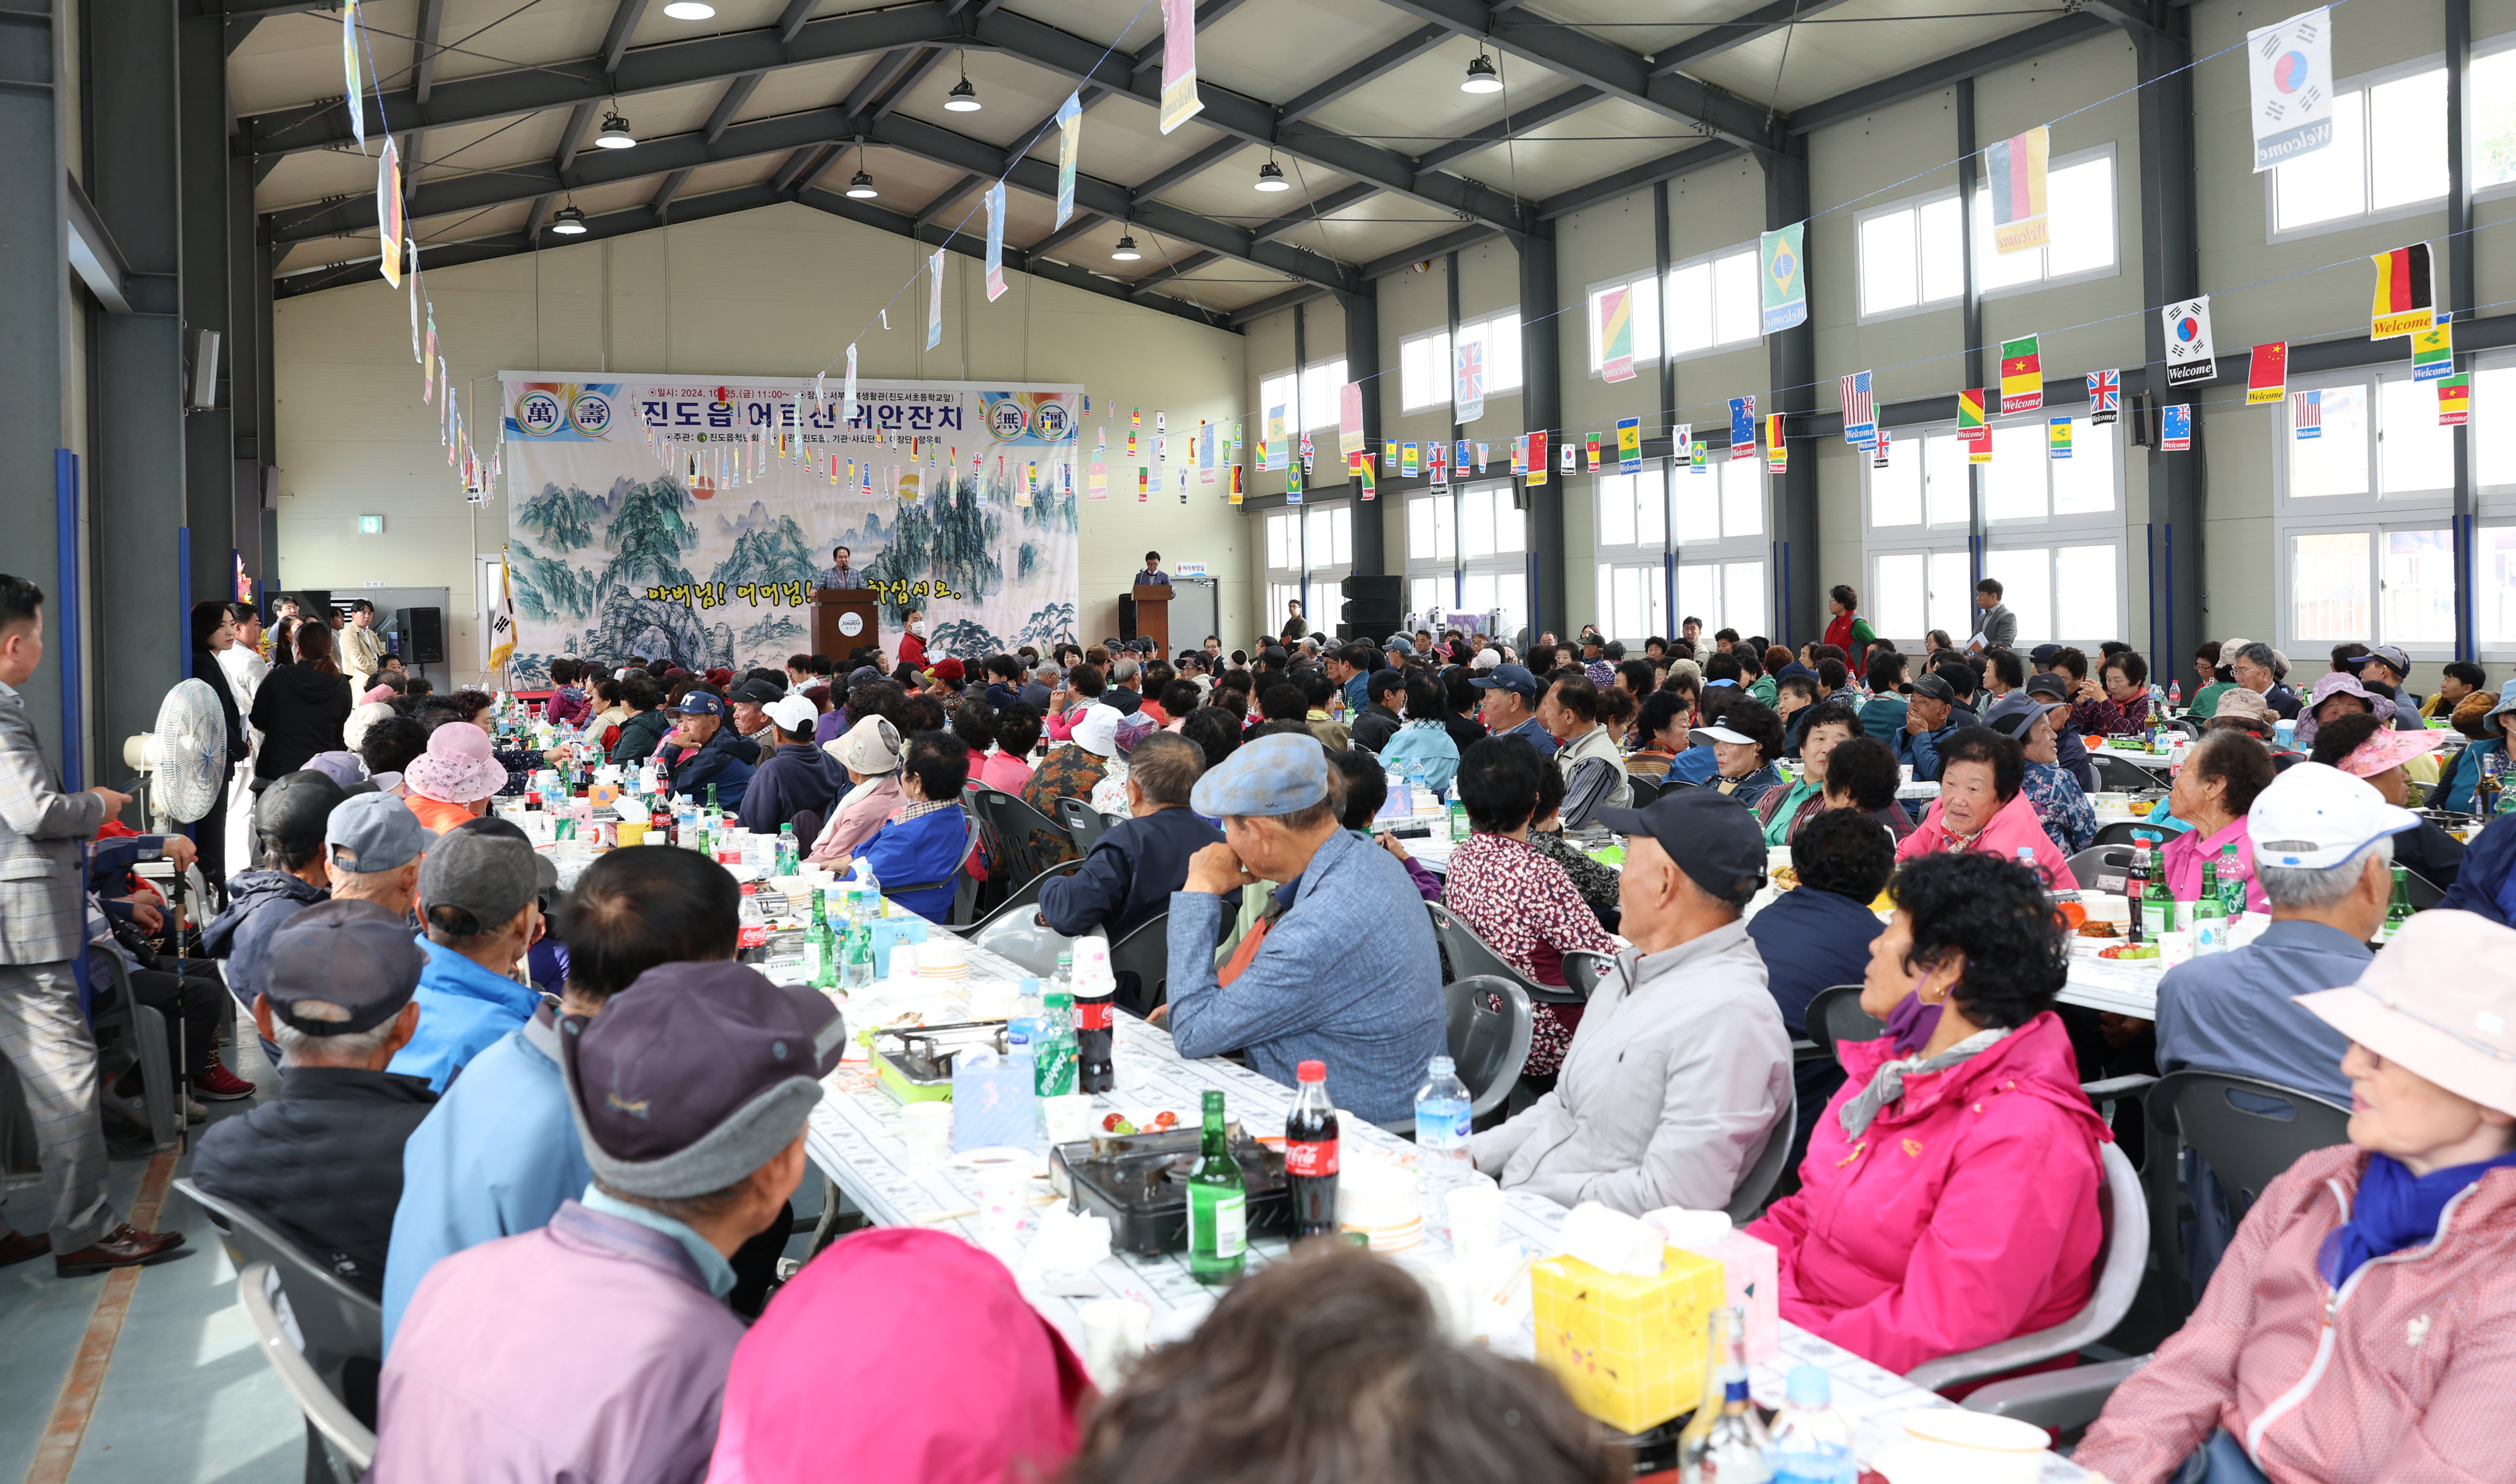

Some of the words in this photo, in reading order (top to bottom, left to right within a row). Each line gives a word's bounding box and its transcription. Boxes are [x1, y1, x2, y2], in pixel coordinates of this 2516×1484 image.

[2373, 316, 2431, 333] Welcome
[2169, 362, 2212, 379] Welcome
[2414, 364, 2452, 380] Welcome
[657, 388, 677, 397] 일시:
[681, 389, 705, 397] 2024.
[2248, 390, 2283, 402] Welcome
[2003, 398, 2040, 410] Welcome
[525, 402, 553, 424] 萬
[578, 403, 606, 424] 壽
[642, 402, 731, 427] 진도읍
[2092, 414, 2116, 423] Welcome
[2440, 414, 2468, 424] Welcome
[674, 433, 693, 441] 주관:
[1846, 428, 1874, 439] Welcome
[2297, 428, 2321, 438] Welcome
[1733, 448, 1754, 457] Welcome
[1620, 464, 1641, 472] Welcome
[647, 582, 726, 609] 아버님!
[737, 581, 812, 608] 어머님!
